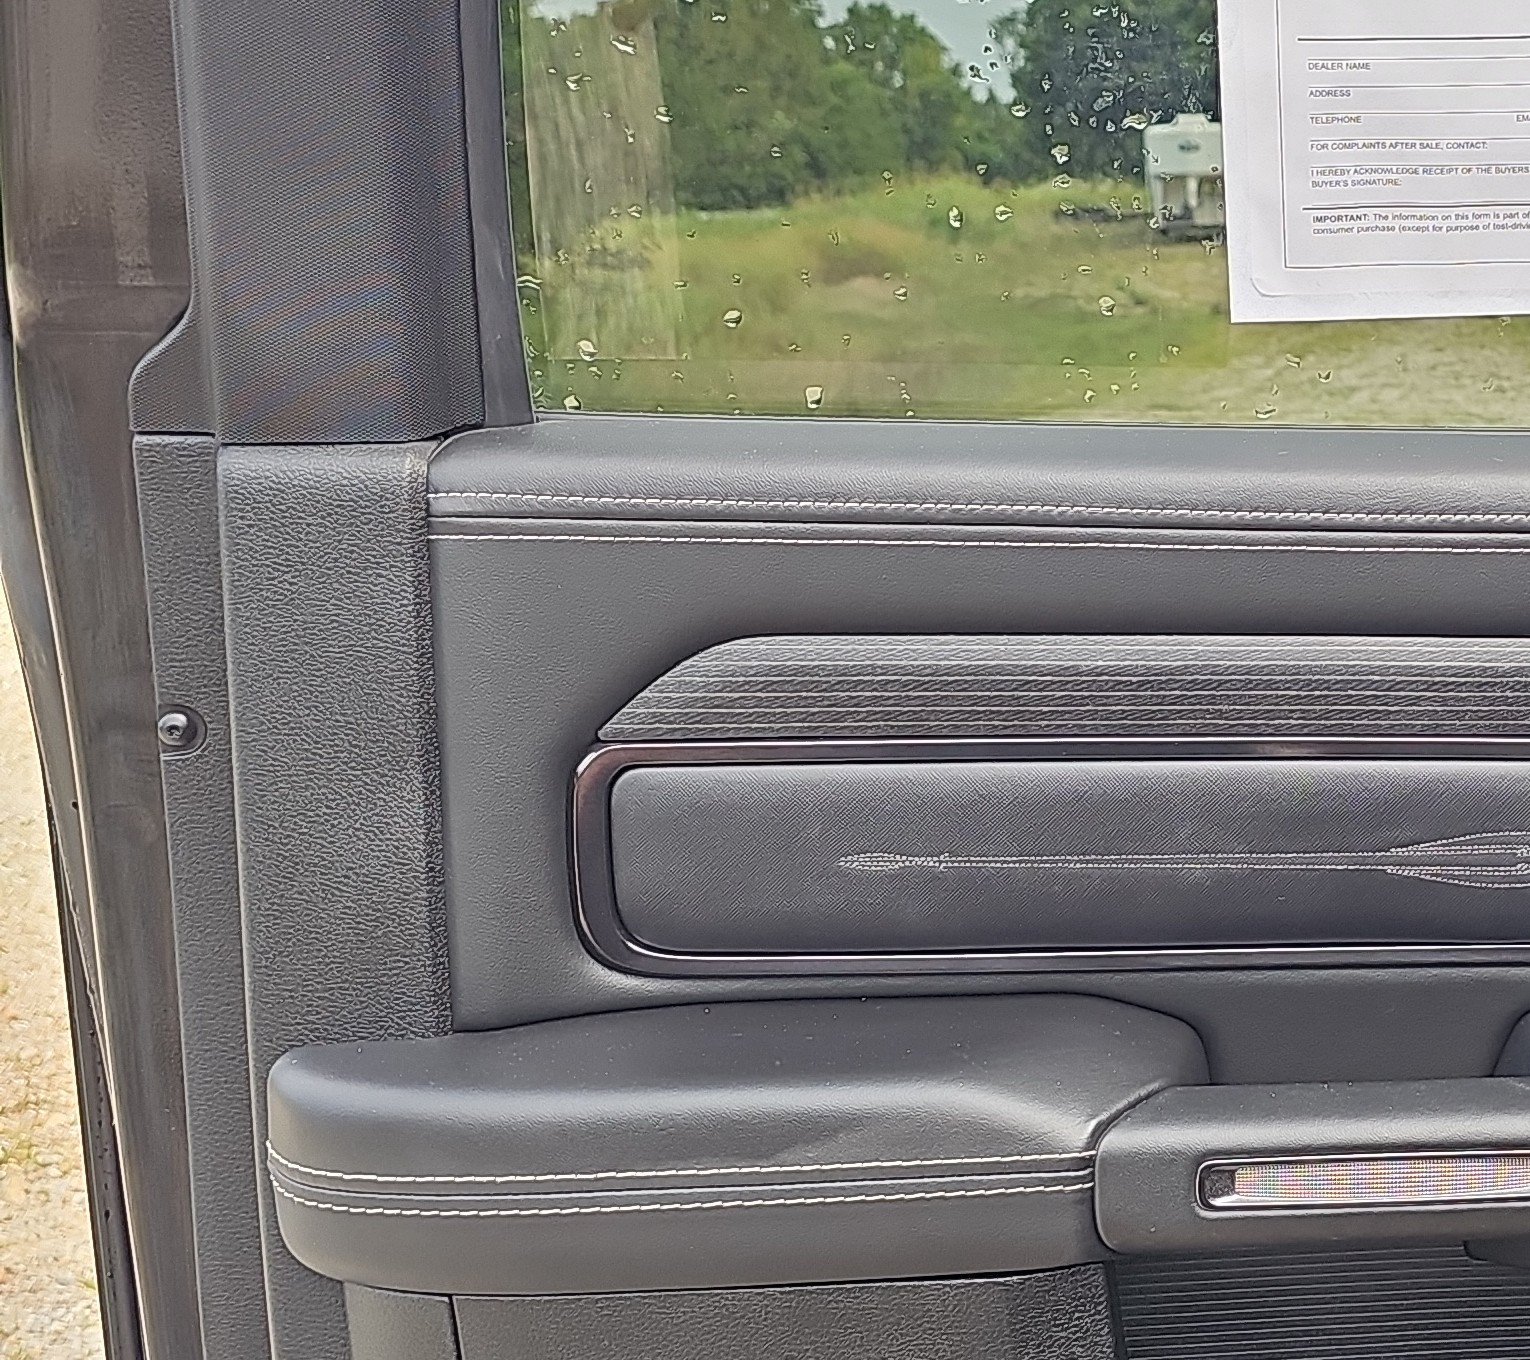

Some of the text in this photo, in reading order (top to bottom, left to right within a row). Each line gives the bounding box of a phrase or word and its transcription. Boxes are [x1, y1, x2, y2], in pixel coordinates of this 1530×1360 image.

[1308, 62, 1370, 70] DEALER NAME
[1308, 89, 1350, 97] ADDRESS
[1310, 116, 1361, 124] TELEPHONE
[1310, 142, 1328, 151] FOR
[1331, 142, 1386, 150] COMPLAINTS
[1388, 142, 1416, 150] AFTER
[1316, 168, 1350, 177] HEREBY
[1353, 167, 1419, 176] ACKNOWLEDGE
[1422, 166, 1458, 175] RECEIPT
[1461, 166, 1472, 174] OF
[1476, 165, 1492, 174] THE
[1312, 213, 1369, 223] IMPORTANT:
[1374, 212, 1388, 221] The
[1391, 211, 1438, 221] information
[1441, 212, 1451, 220] on
[1454, 210, 1468, 219] this
[1472, 210, 1490, 219] form
[1493, 210, 1499, 218] is
[1503, 209, 1519, 220] part
[1522, 209, 1530, 218] of
[1313, 226, 1354, 235] consumer
[1356, 224, 1395, 235] purchase
[1432, 223, 1443, 232] for
[1445, 223, 1479, 233] purpose
[1482, 222, 1490, 231] of
